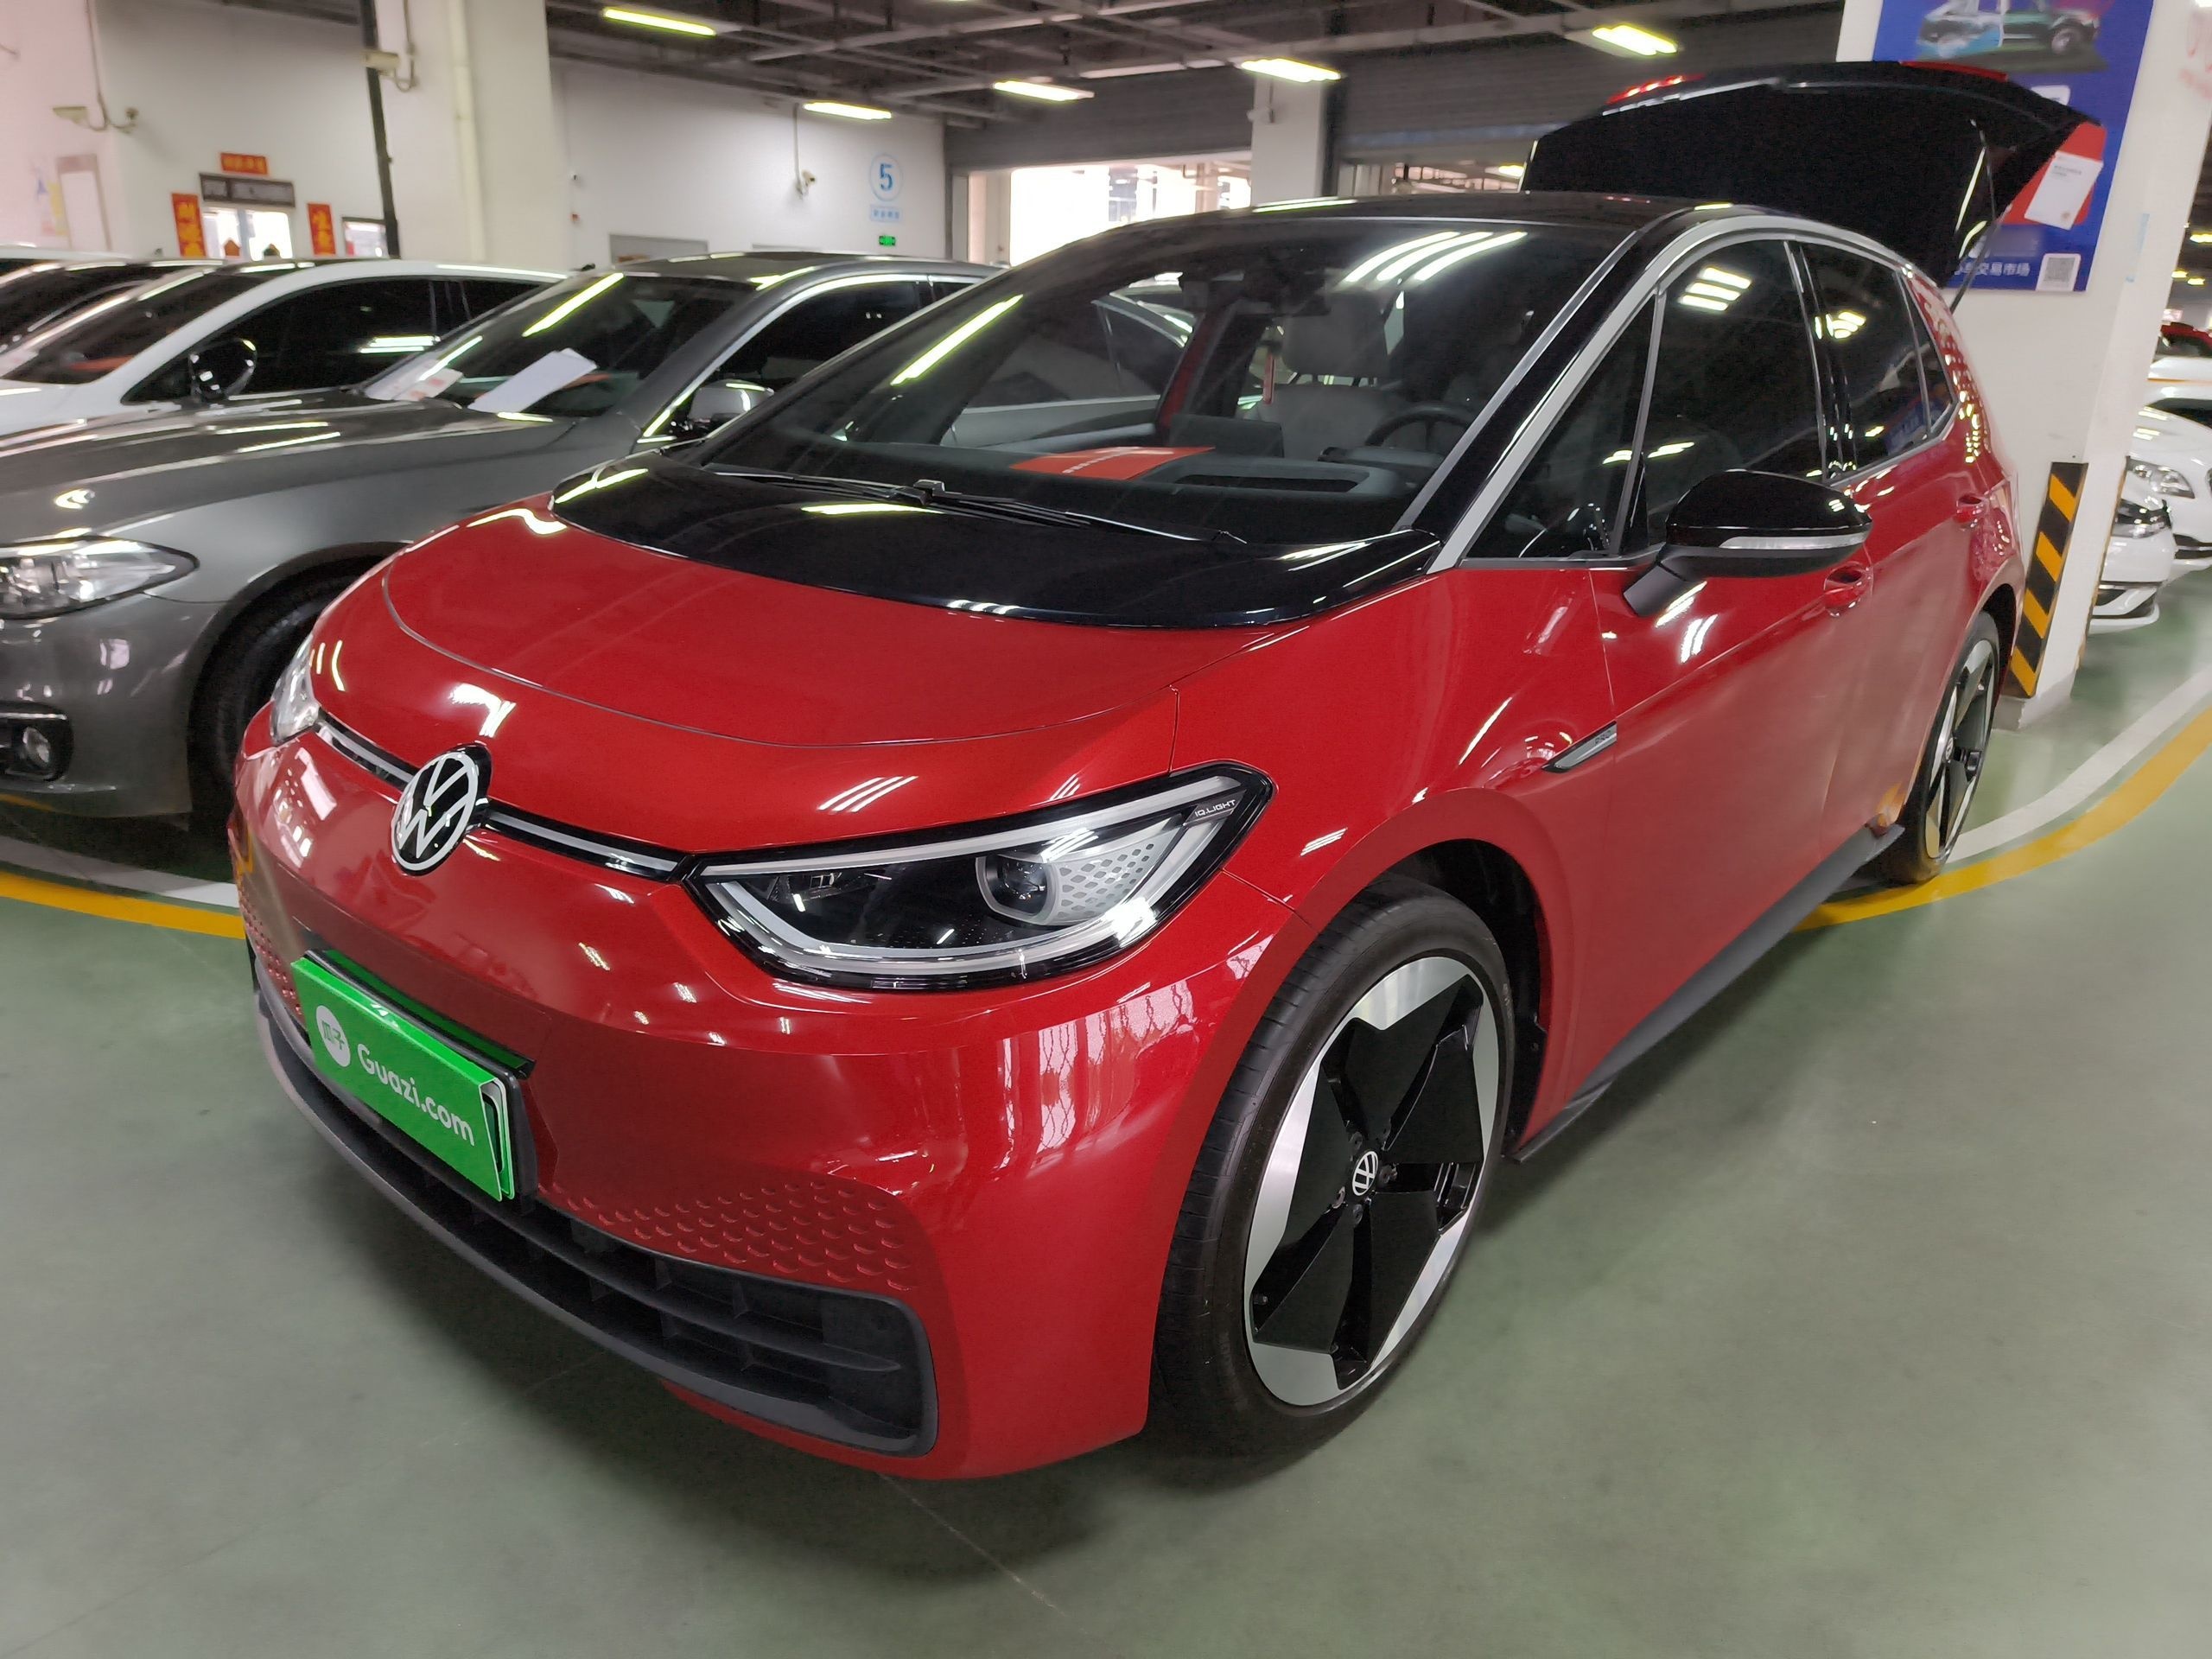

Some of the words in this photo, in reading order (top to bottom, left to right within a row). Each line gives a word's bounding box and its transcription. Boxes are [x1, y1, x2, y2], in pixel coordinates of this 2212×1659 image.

[880, 163, 893, 190] 5
[1194, 799, 1236, 817] IQ.LIGHT
[357, 1043, 475, 1147] Guazi.com
